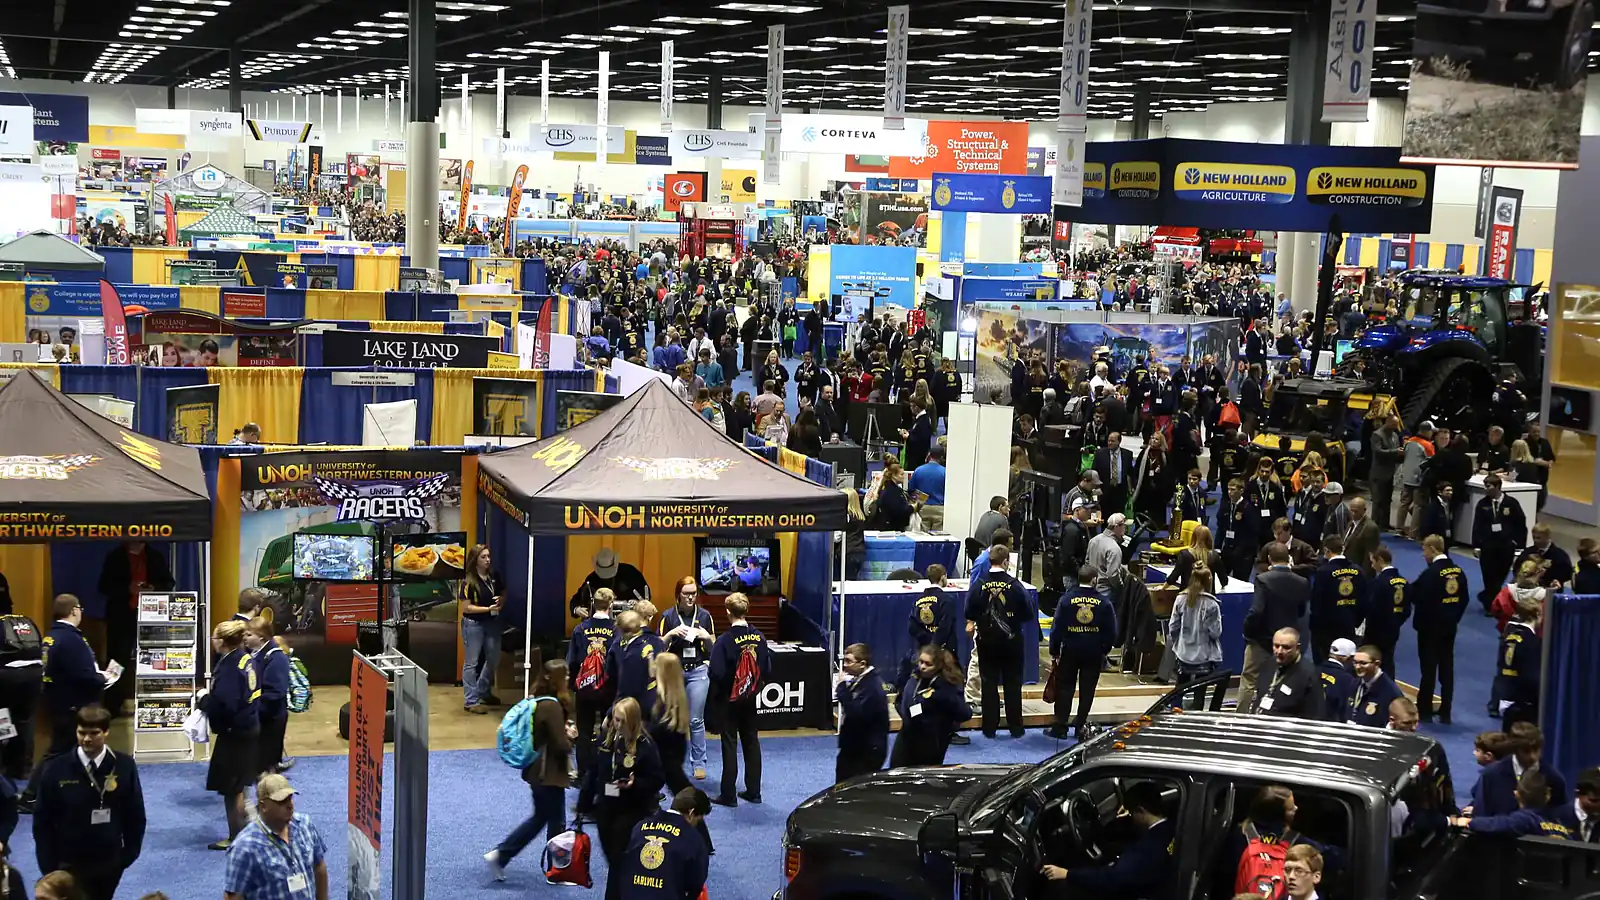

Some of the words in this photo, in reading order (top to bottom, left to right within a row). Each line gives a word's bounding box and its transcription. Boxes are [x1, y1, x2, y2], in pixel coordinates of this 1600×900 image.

[1062, 23, 1075, 97] Aisle
[886, 43, 896, 104] Aisle
[200, 120, 232, 131] syngenta
[264, 126, 299, 136] PURDUE
[548, 129, 573, 140] CHS
[821, 128, 876, 140] CORTEVA
[961, 129, 996, 140] Power,
[686, 134, 711, 146] CHS
[947, 139, 998, 150] Structural
[1000, 140, 1009, 149] &
[953, 149, 1003, 160] Technical
[957, 160, 999, 172] Systems
[1121, 172, 1132, 182] NEW
[1133, 172, 1156, 182] HOLLAND
[1203, 172, 1231, 184] NEW
[1233, 174, 1287, 186] HOLLAND
[1335, 177, 1360, 188] NEW
[1364, 178, 1417, 190] HOLLAND
[1118, 189, 1150, 198] CONSTRUCTION
[1201, 191, 1266, 202] AGRICULTURE
[1328, 195, 1402, 205] CONSTRUCTION
[879, 204, 924, 213] STIHLusa.com
[1496, 230, 1510, 279] RAM
[53, 290, 76, 298] College
[151, 318, 169, 326] LAKE
[363, 339, 407, 357] LAKE
[412, 341, 459, 359] LAND
[373, 360, 449, 369] COLLEGE
[316, 462, 366, 471] UNIVERSITY
[258, 463, 312, 484] UNOH
[316, 470, 412, 480] NORTHWESTERN
[416, 471, 443, 480] OHIO
[370, 487, 394, 496] UNOH
[338, 497, 425, 520] RACERS
[651, 505, 716, 515] UNIVERSITY
[717, 505, 728, 514] OF
[52, 514, 66, 522] OF
[564, 503, 645, 529] UNOH
[651, 514, 775, 528] NORTHWESTERN
[778, 514, 816, 527] OHIO
[128, 524, 173, 537] OHIO
[1332, 568, 1358, 577] COLORADO
[1440, 567, 1462, 577] COLORADO
[1071, 597, 1101, 606] KENTUCKY
[356, 730, 362, 747] TO
[641, 822, 681, 837] ILLINOIS
[633, 874, 663, 889] EARLVILLE
